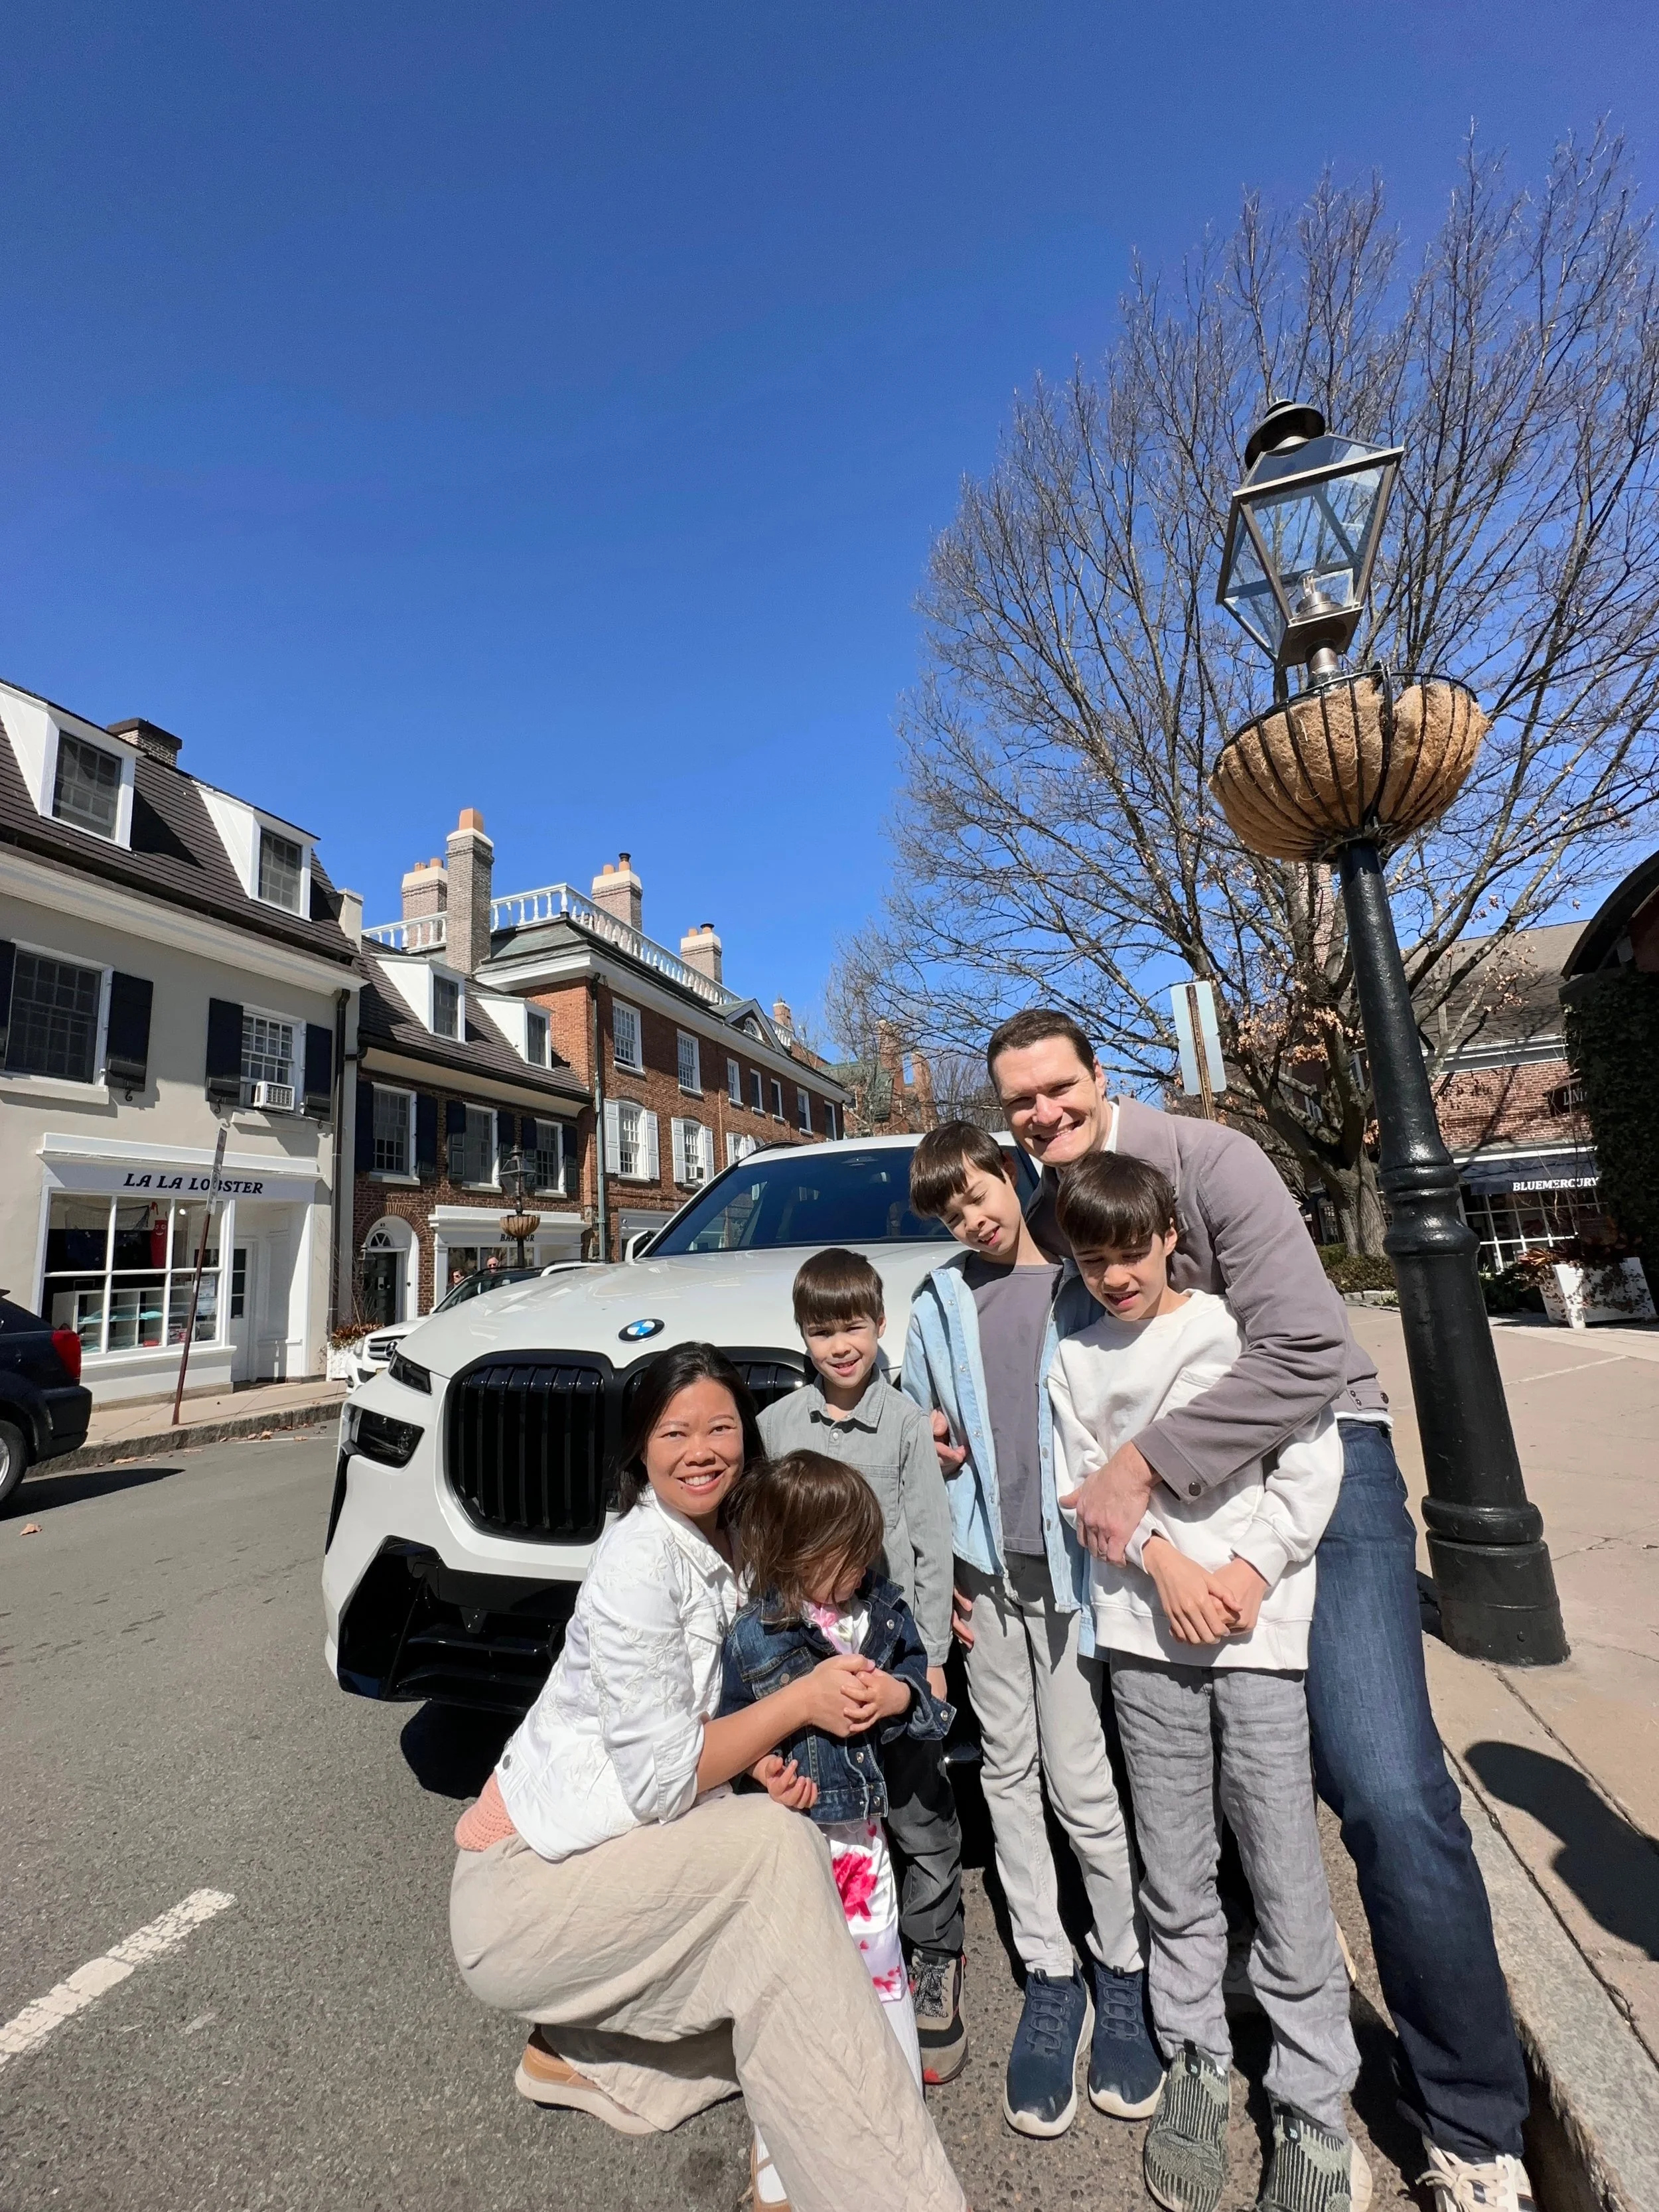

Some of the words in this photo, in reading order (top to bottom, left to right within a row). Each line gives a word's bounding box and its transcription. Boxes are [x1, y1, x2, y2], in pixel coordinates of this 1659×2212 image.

[123, 1173, 152, 1187] LA
[157, 1175, 183, 1189] LA
[1512, 1177, 1600, 1191] BLUEMERCURY
